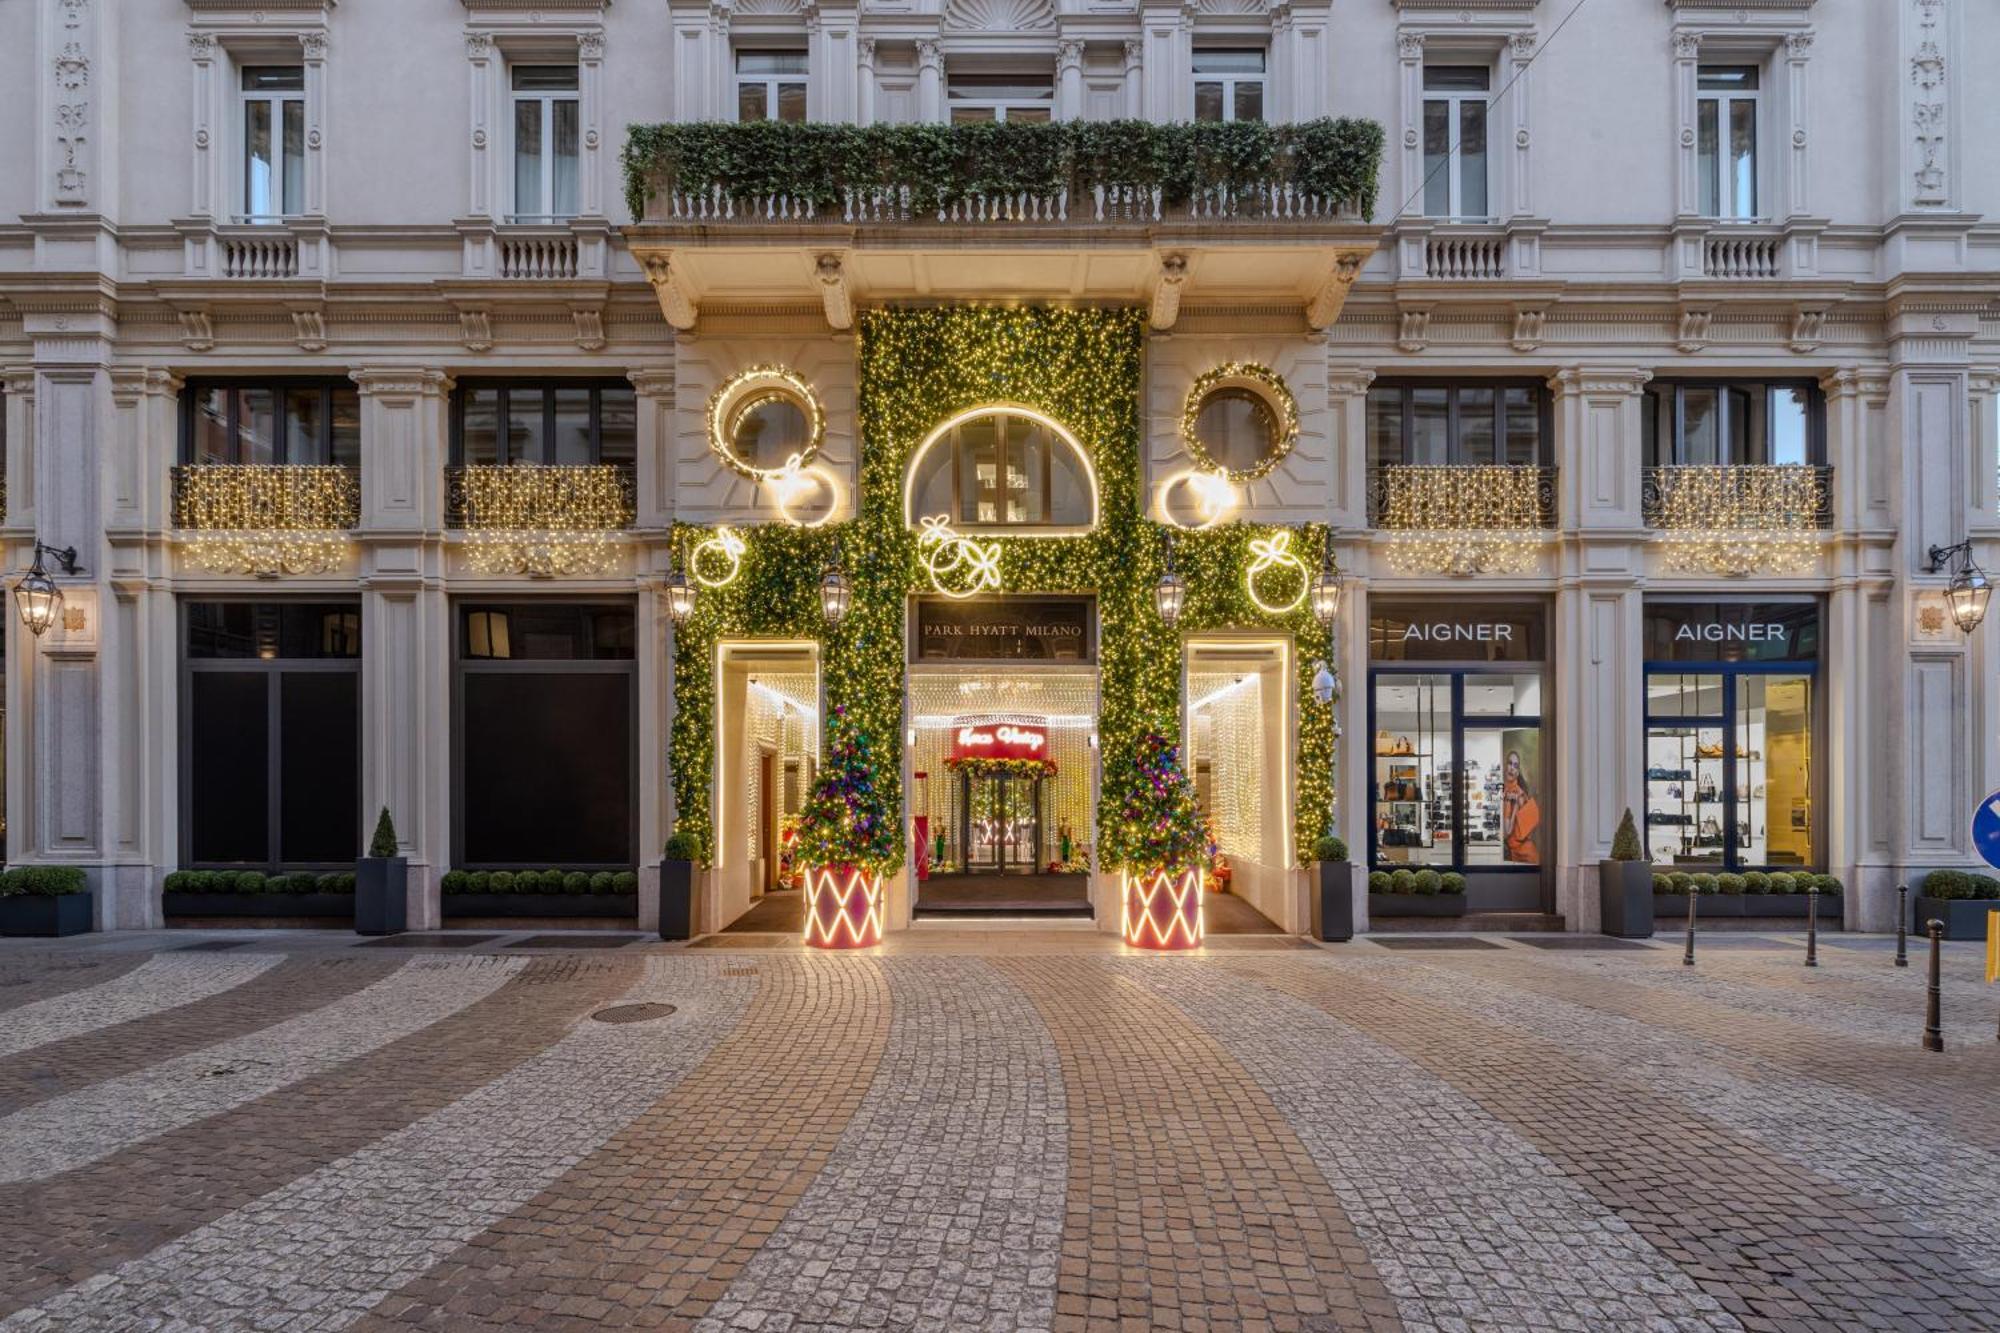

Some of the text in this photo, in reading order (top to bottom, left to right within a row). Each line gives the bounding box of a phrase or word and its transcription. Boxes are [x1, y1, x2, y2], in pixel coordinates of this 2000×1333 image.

[924, 625, 1082, 637] PARK HYATT MILANO
[1403, 623, 1512, 641] AIGNER
[1675, 623, 1785, 641] AIGNER
